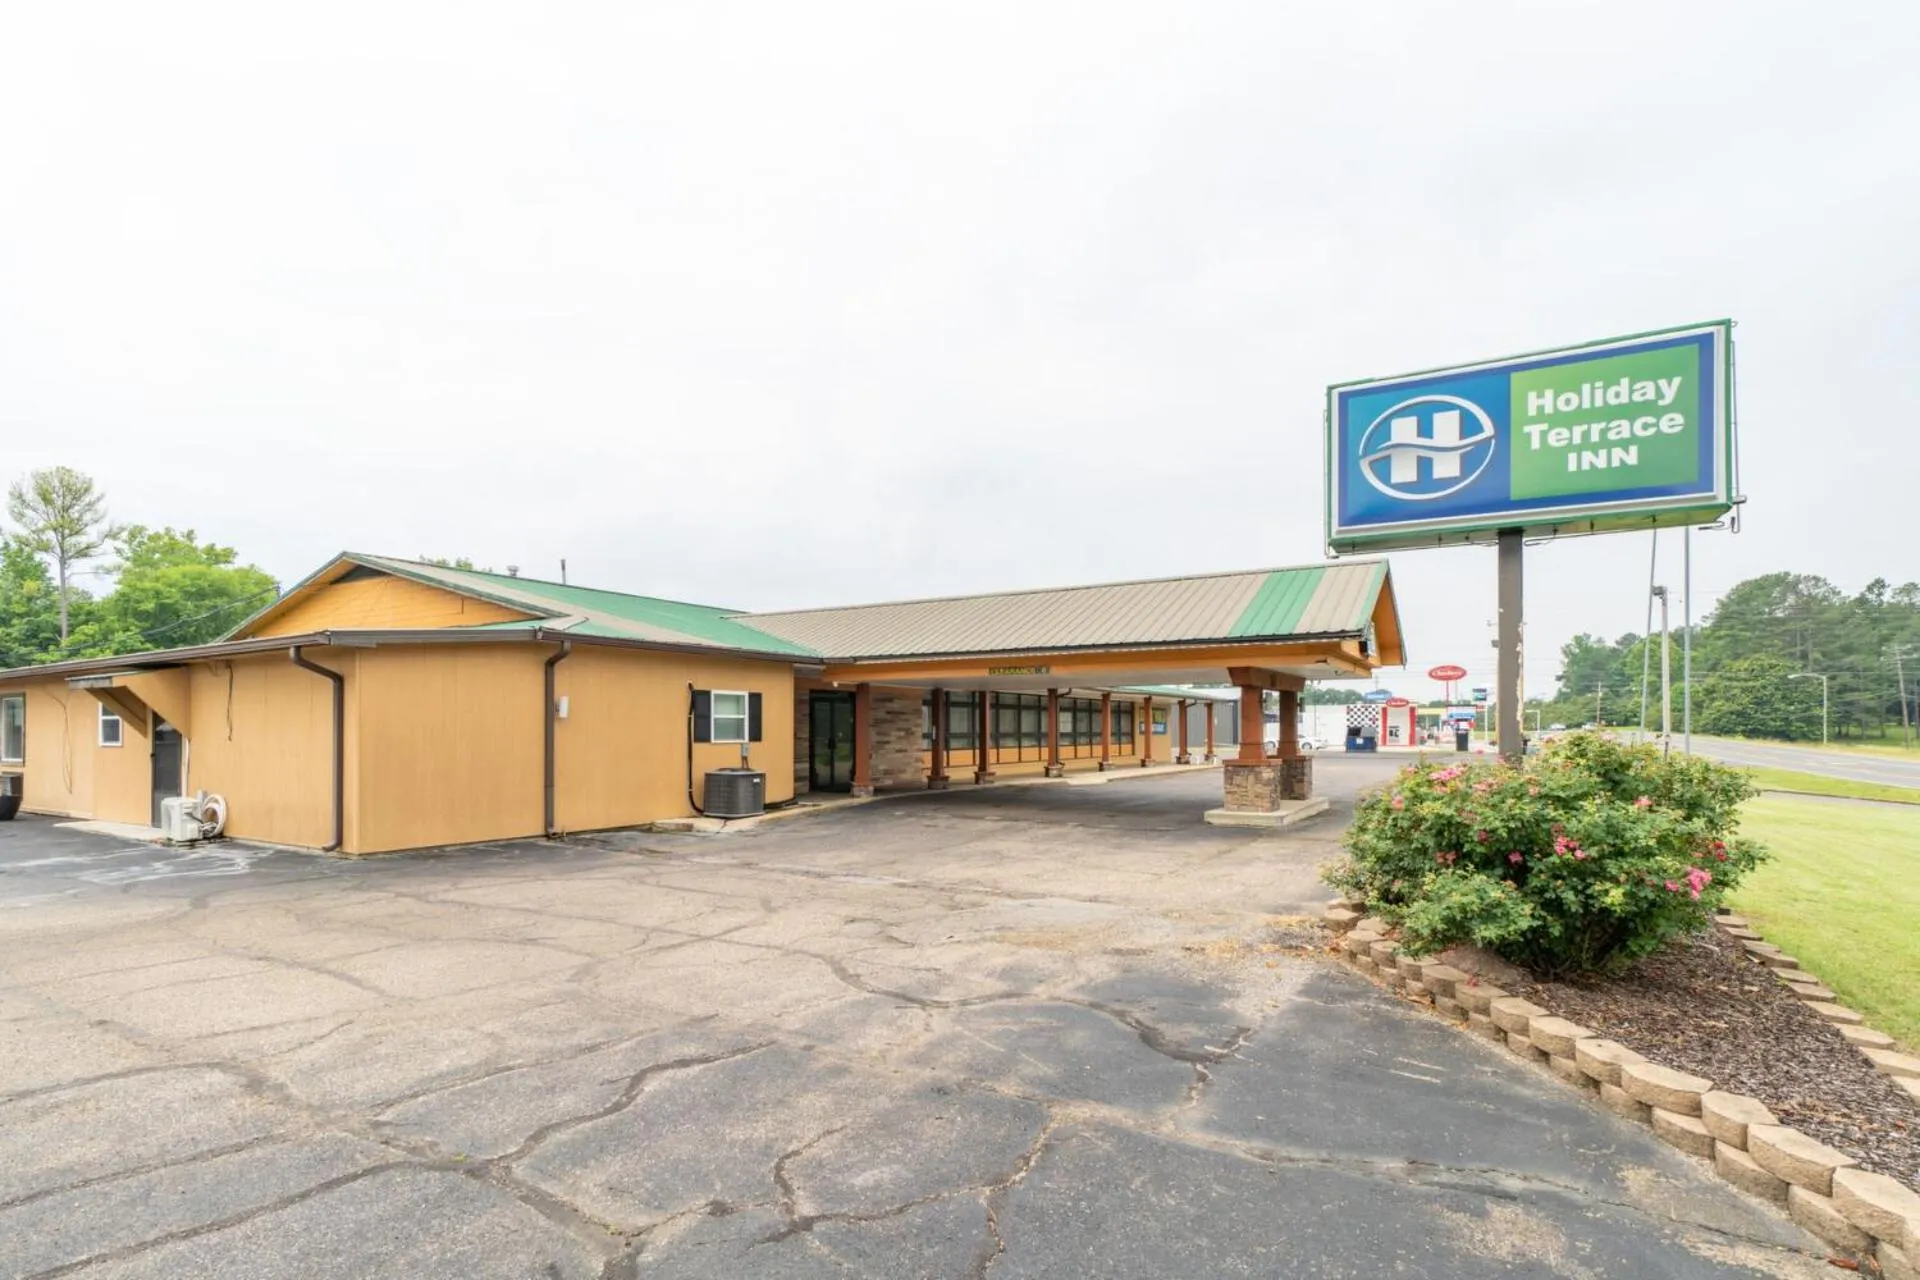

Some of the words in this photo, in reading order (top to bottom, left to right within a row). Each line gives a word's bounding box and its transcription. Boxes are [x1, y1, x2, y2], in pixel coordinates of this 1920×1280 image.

[1527, 376, 1682, 416] Holiday
[1390, 410, 1461, 484] H
[1523, 412, 1685, 450] Terrace
[1567, 445, 1638, 472] INN
